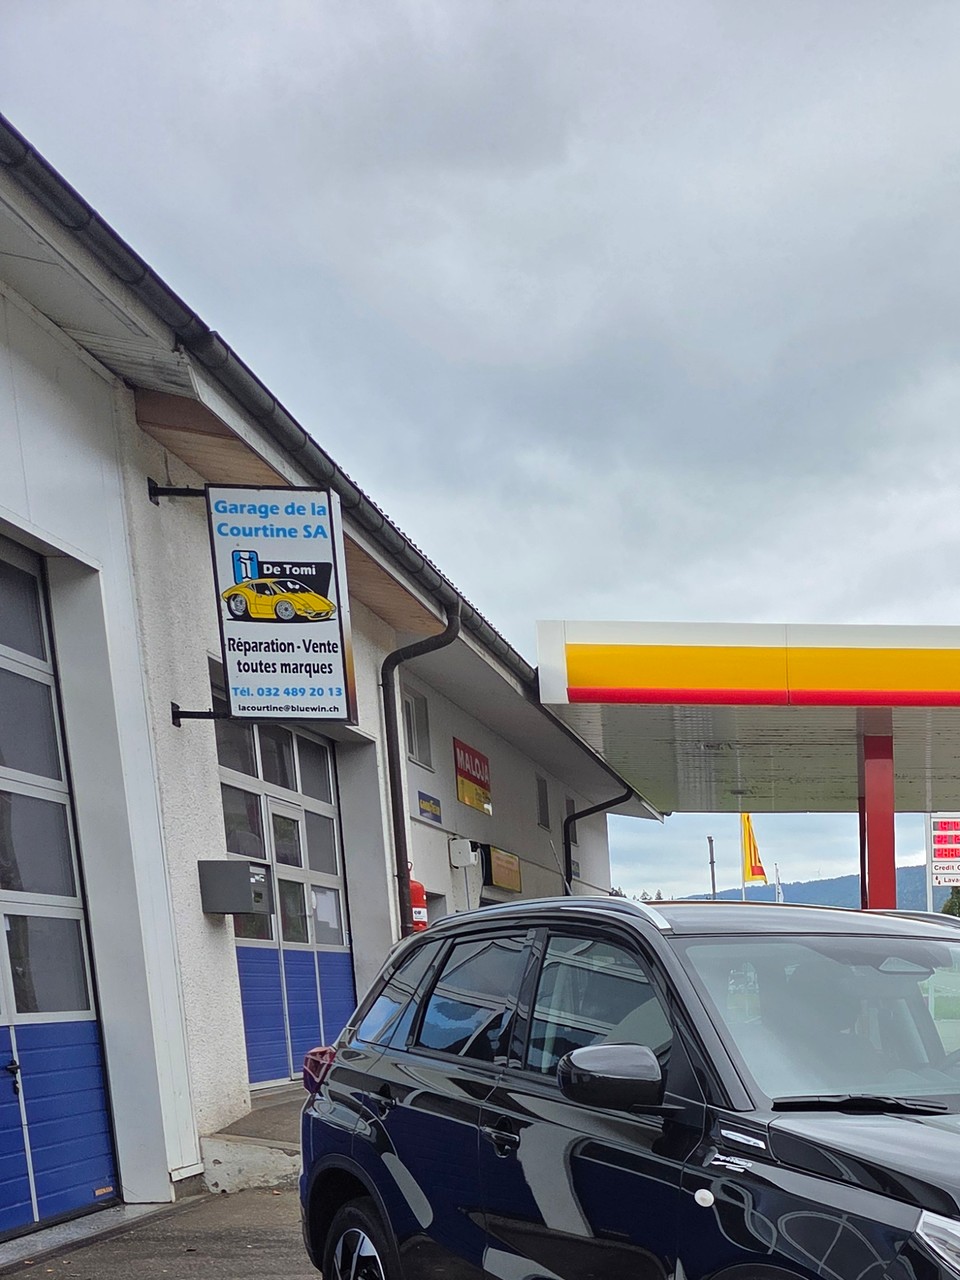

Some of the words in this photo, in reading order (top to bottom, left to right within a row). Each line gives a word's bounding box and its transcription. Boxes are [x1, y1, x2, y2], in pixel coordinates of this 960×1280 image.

[214, 500, 280, 519] Garage
[284, 502, 307, 516] de
[311, 502, 327, 516] la
[216, 522, 298, 538] Courtine
[303, 524, 328, 539] SA
[263, 564, 281, 575] De
[283, 564, 317, 575] Tomi
[227, 637, 295, 656] Réparation
[302, 639, 339, 653] Vente
[237, 660, 277, 673] toutes
[280, 662, 333, 678] marques
[232, 686, 254, 697] Tél.
[256, 687, 280, 697] 032
[283, 687, 306, 697] 489
[309, 687, 325, 697] 20
[328, 687, 343, 697] 13
[238, 704, 340, 713] lacourtine@bluewin.ch
[456, 747, 490, 783] MALOJA
